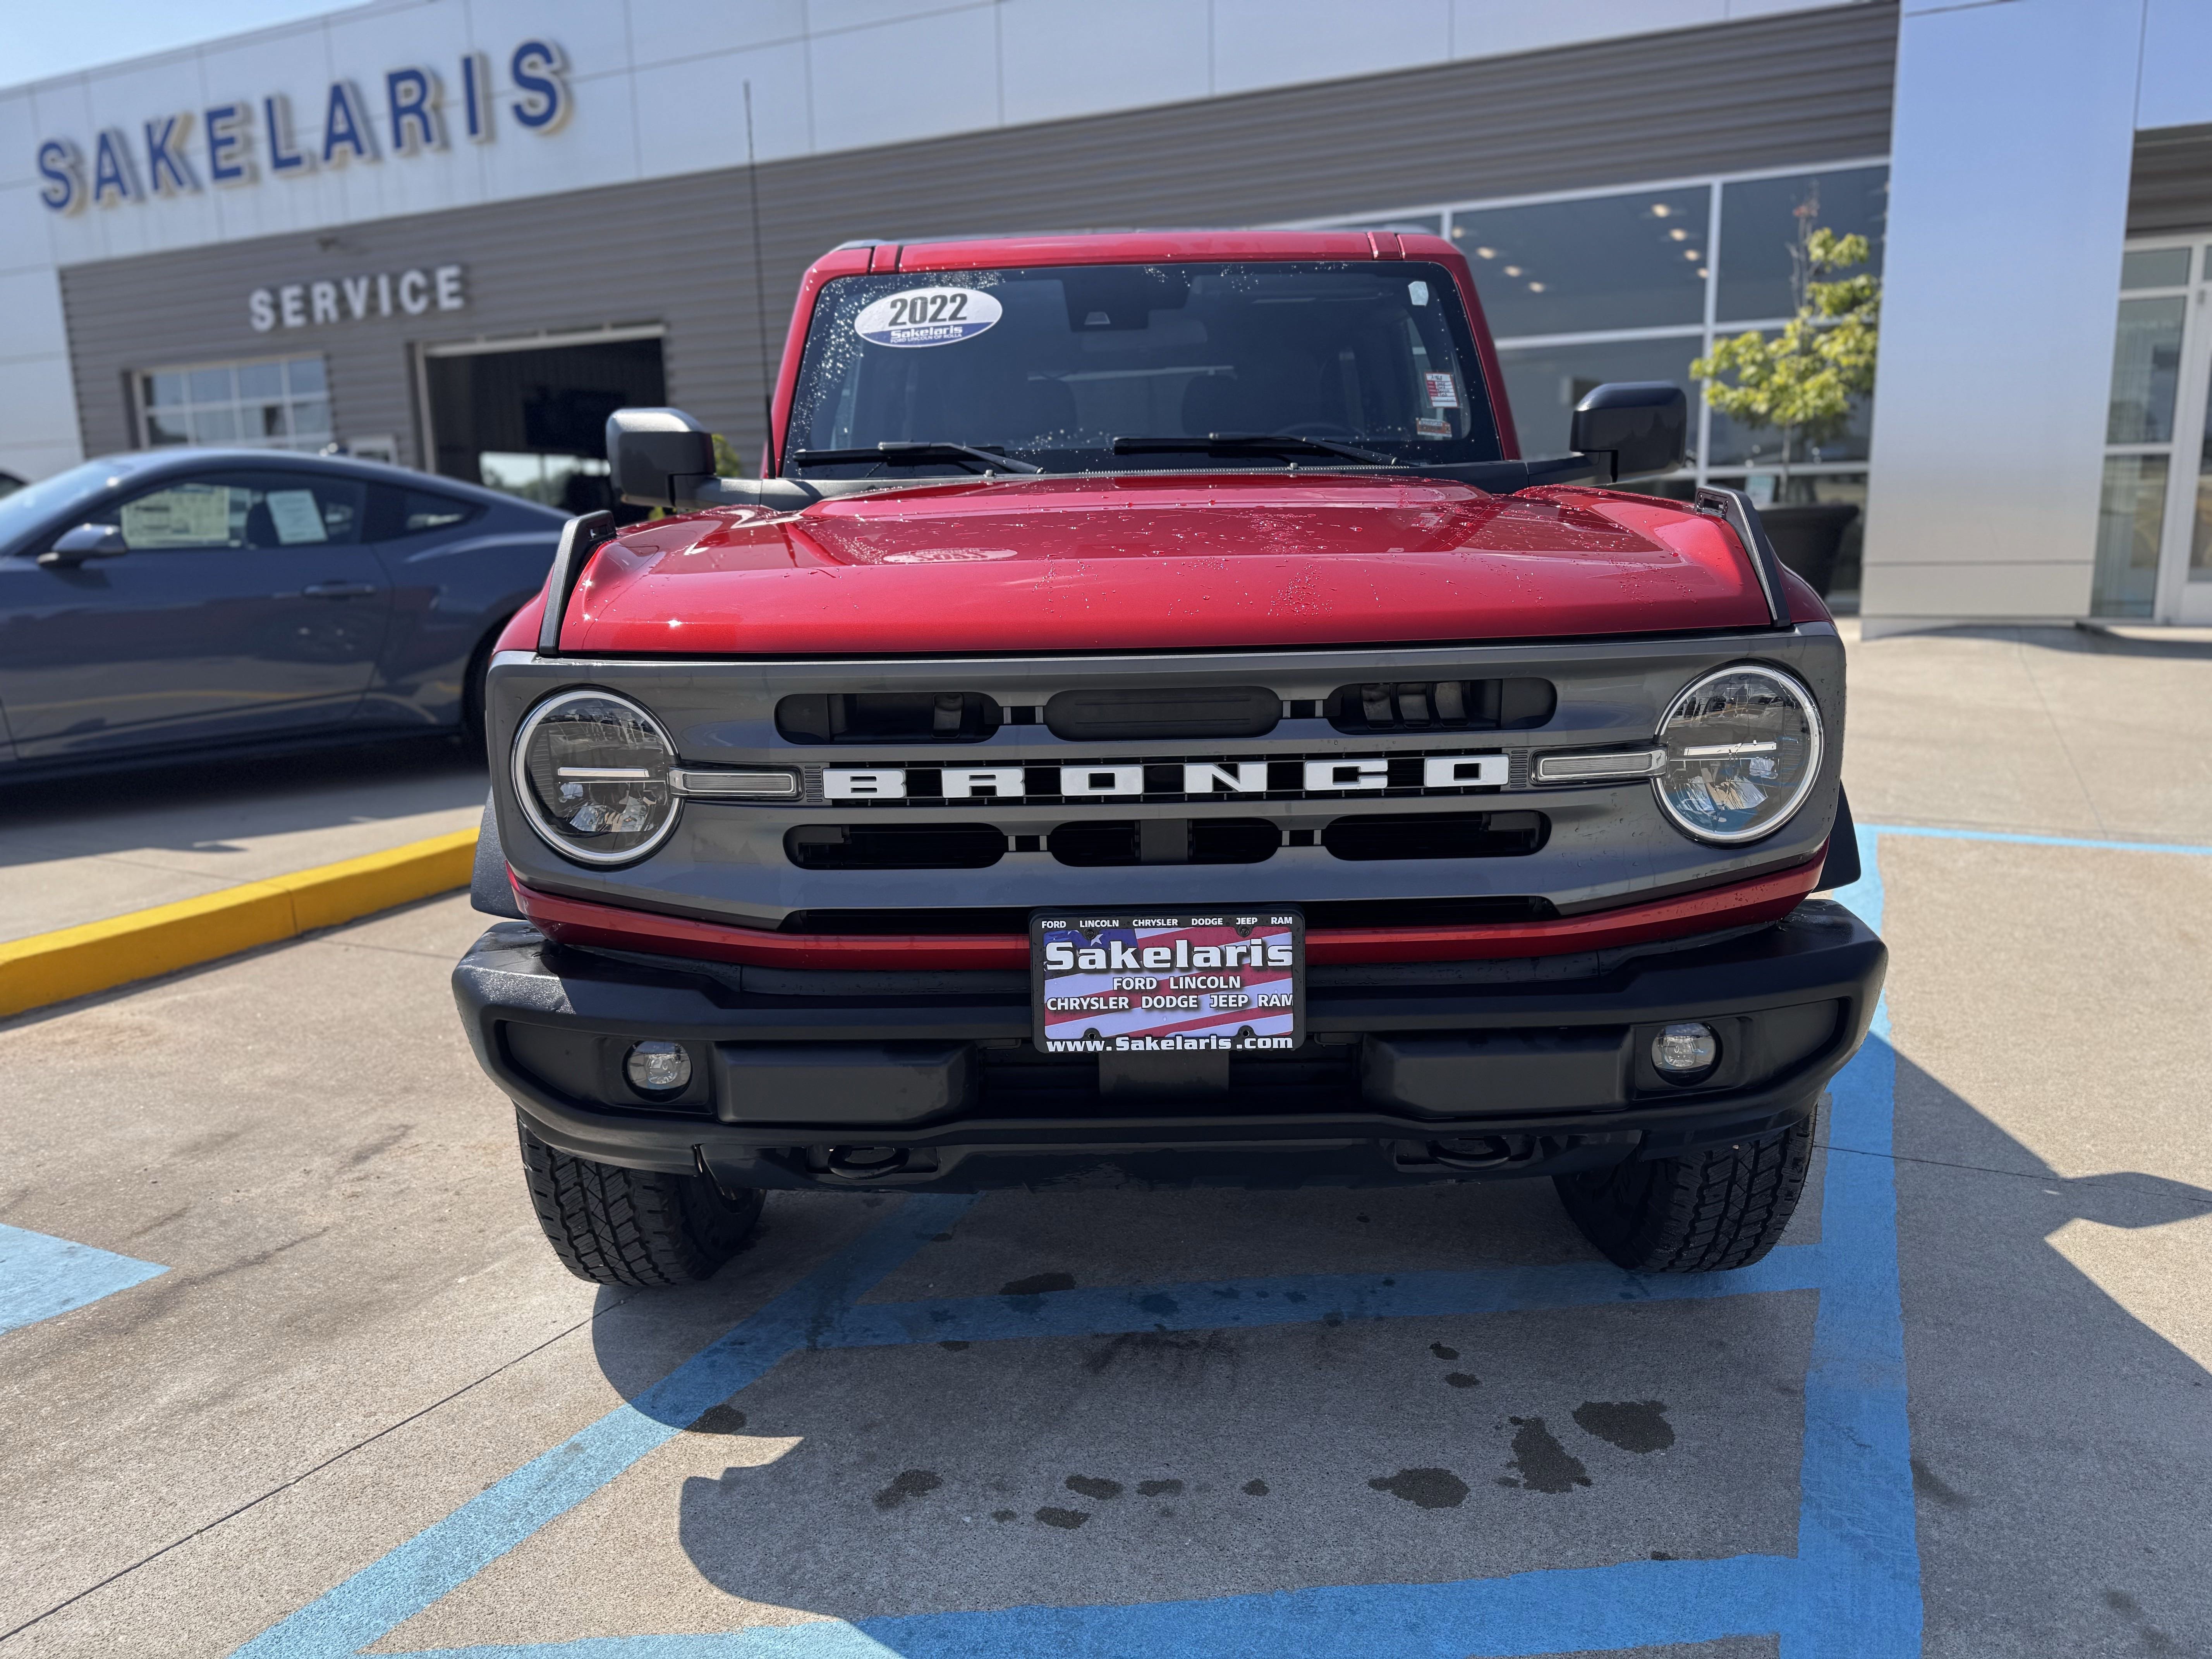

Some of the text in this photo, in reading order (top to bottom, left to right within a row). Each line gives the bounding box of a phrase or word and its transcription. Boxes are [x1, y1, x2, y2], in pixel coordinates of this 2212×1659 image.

[37, 40, 567, 212] SAKELARIS
[248, 265, 465, 332] SERVICE
[888, 293, 968, 327] 2022
[891, 325, 963, 339] Sakelaris
[823, 754, 1510, 799] BRONCO
[1042, 921, 1066, 929] FORD
[1080, 920, 1119, 928] LINCOLN
[1132, 918, 1178, 927] CHRYSLER
[1046, 938, 1293, 970] Sakelaris
[1113, 976, 1240, 990] FORD LINCOLN
[1047, 994, 1293, 1010] CHRYSLER DODGE JEEP RAM
[1046, 1035, 1293, 1052] www.Sakelaris.com
